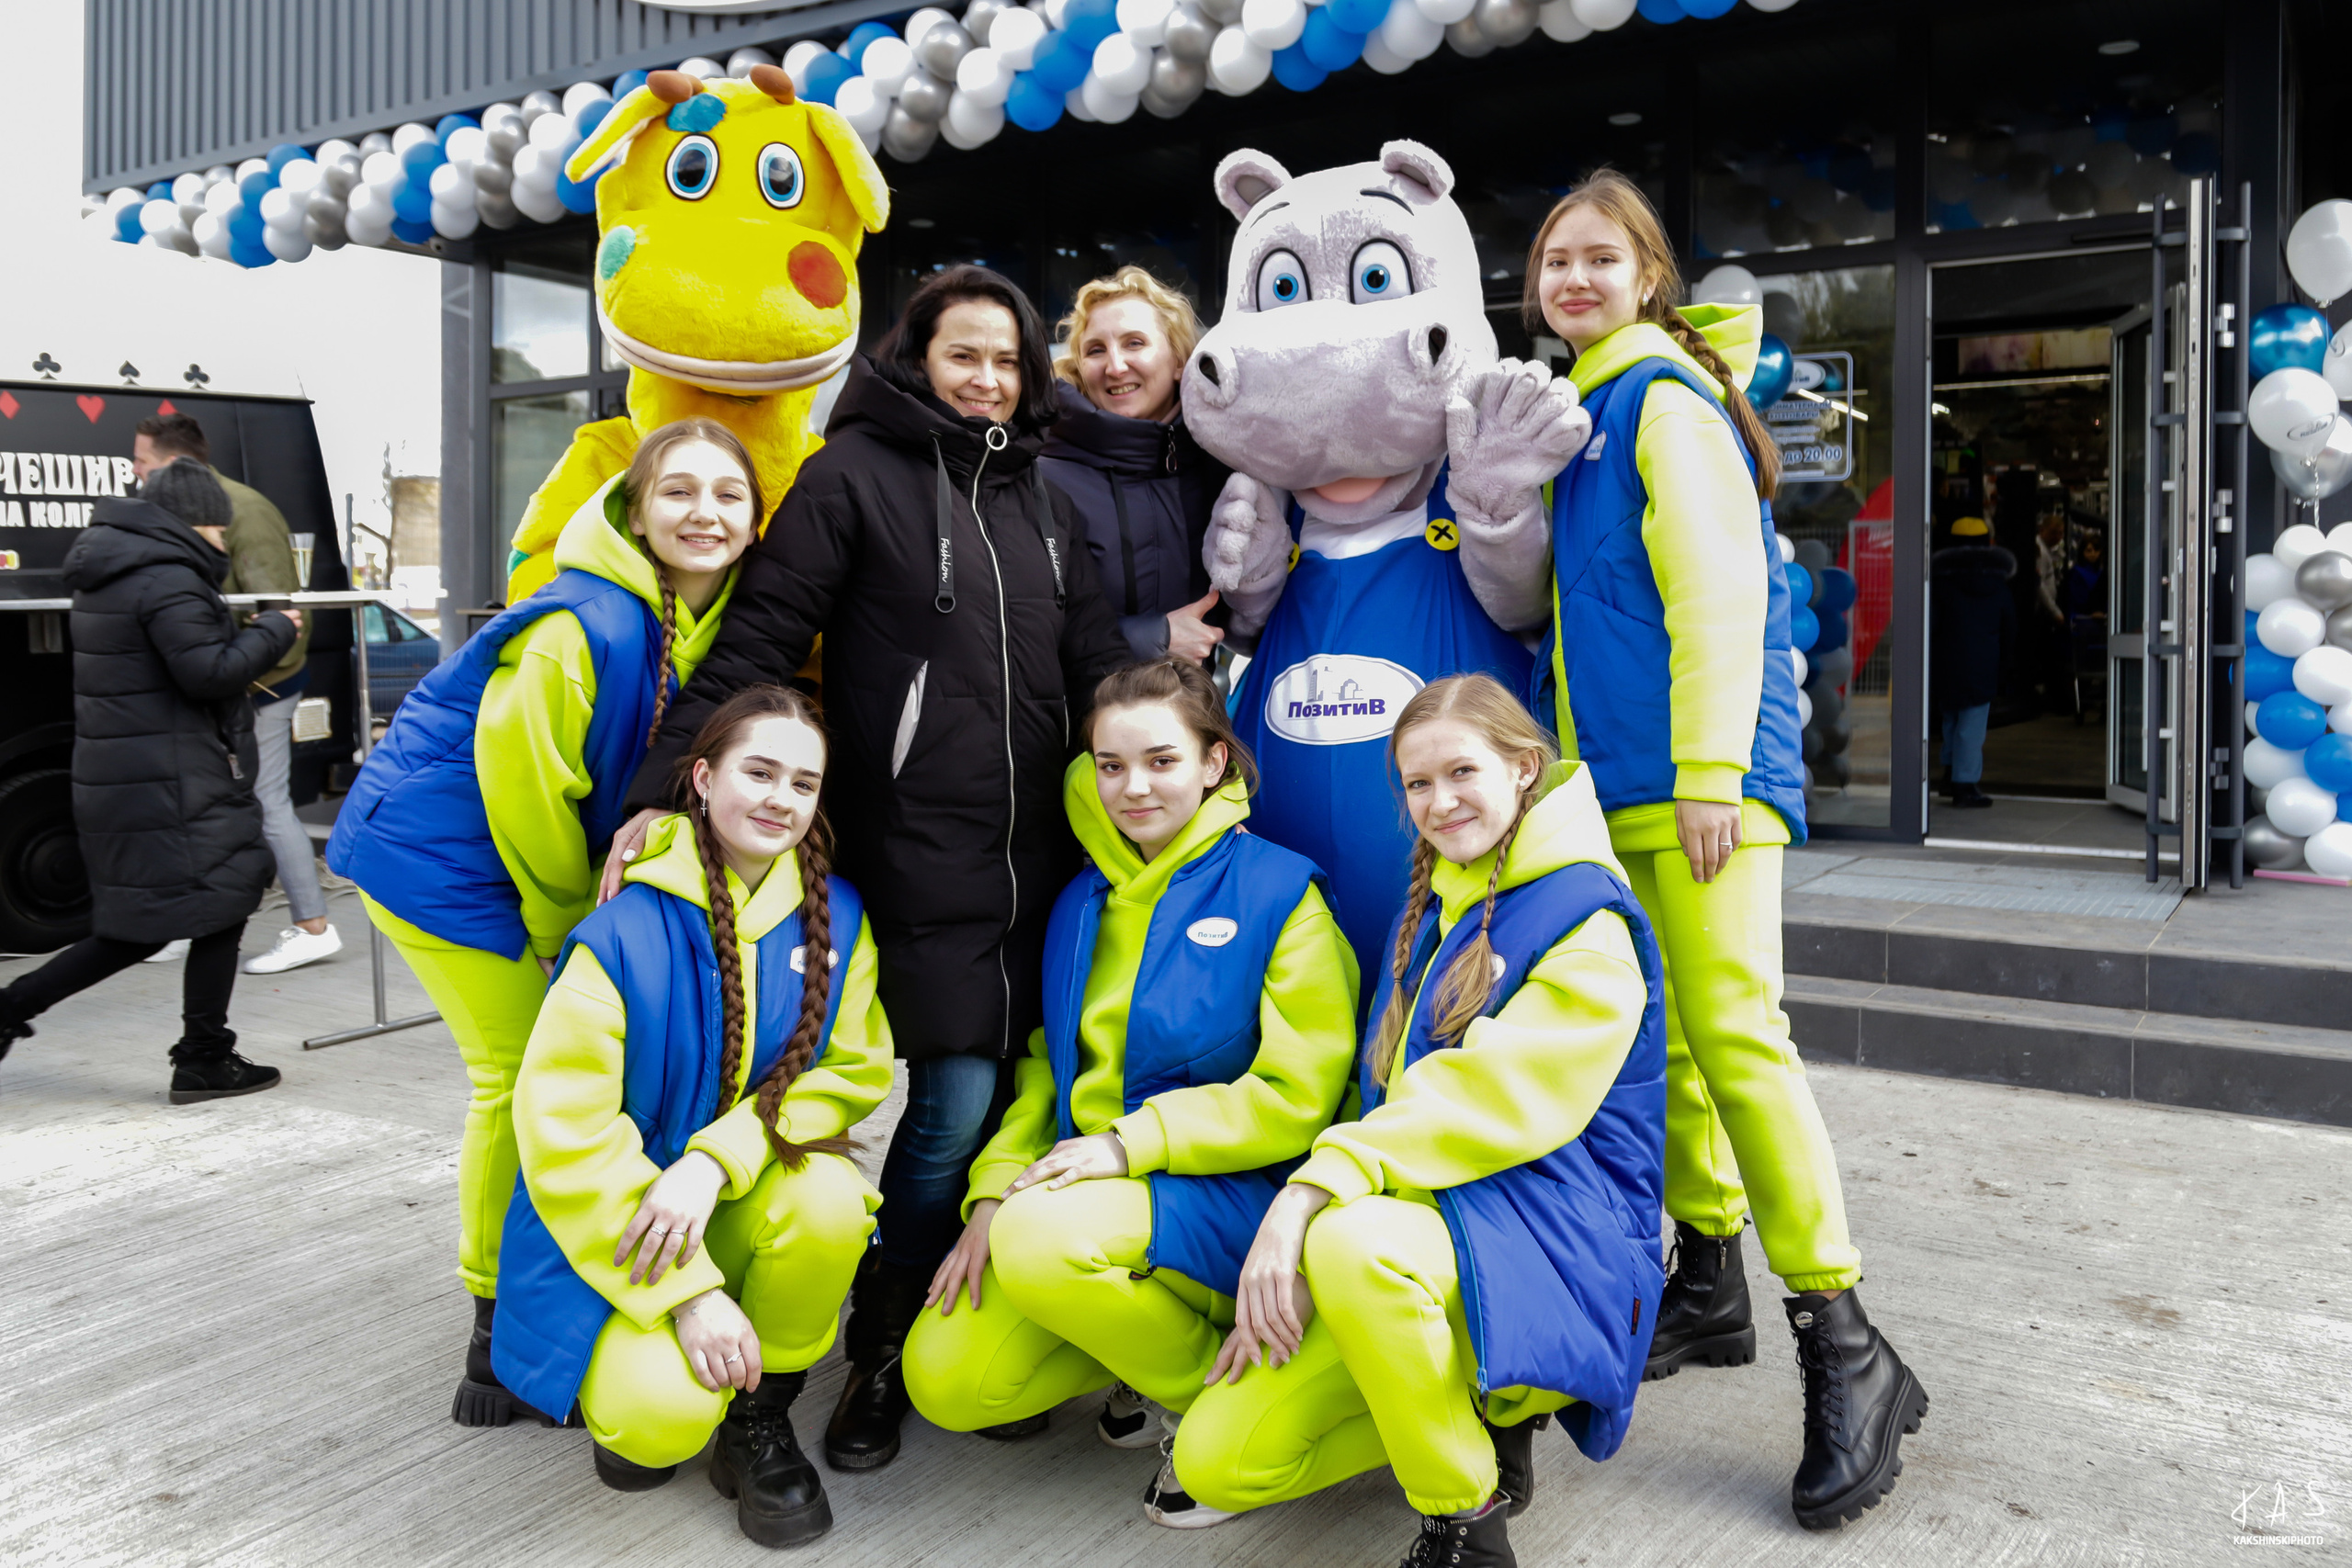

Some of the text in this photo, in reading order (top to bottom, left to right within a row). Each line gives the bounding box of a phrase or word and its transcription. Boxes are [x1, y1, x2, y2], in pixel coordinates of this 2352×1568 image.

[0, 452, 143, 497] ЧЕШИР
[940, 537, 951, 582] Fashion
[1046, 537, 1060, 581] Fashion
